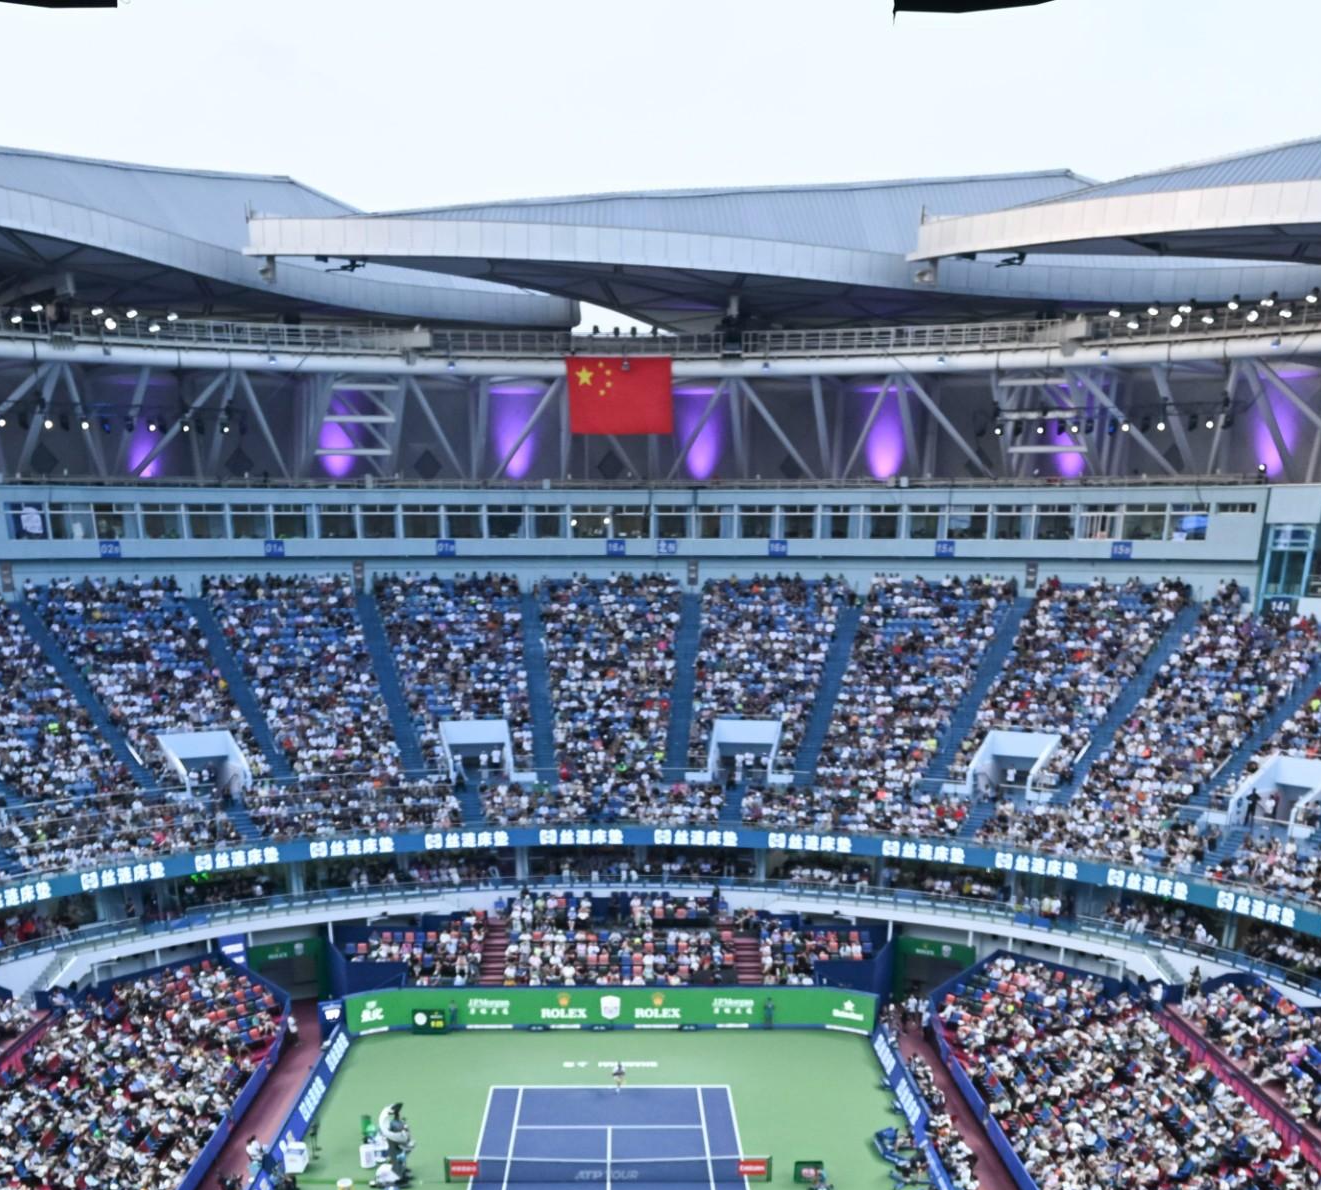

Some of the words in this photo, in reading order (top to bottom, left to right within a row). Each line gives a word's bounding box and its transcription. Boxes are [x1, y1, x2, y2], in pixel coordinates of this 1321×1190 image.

[1271, 601, 1290, 611] 14A
[541, 1008, 588, 1019] ROLEX
[634, 1008, 681, 1019] ROLEX
